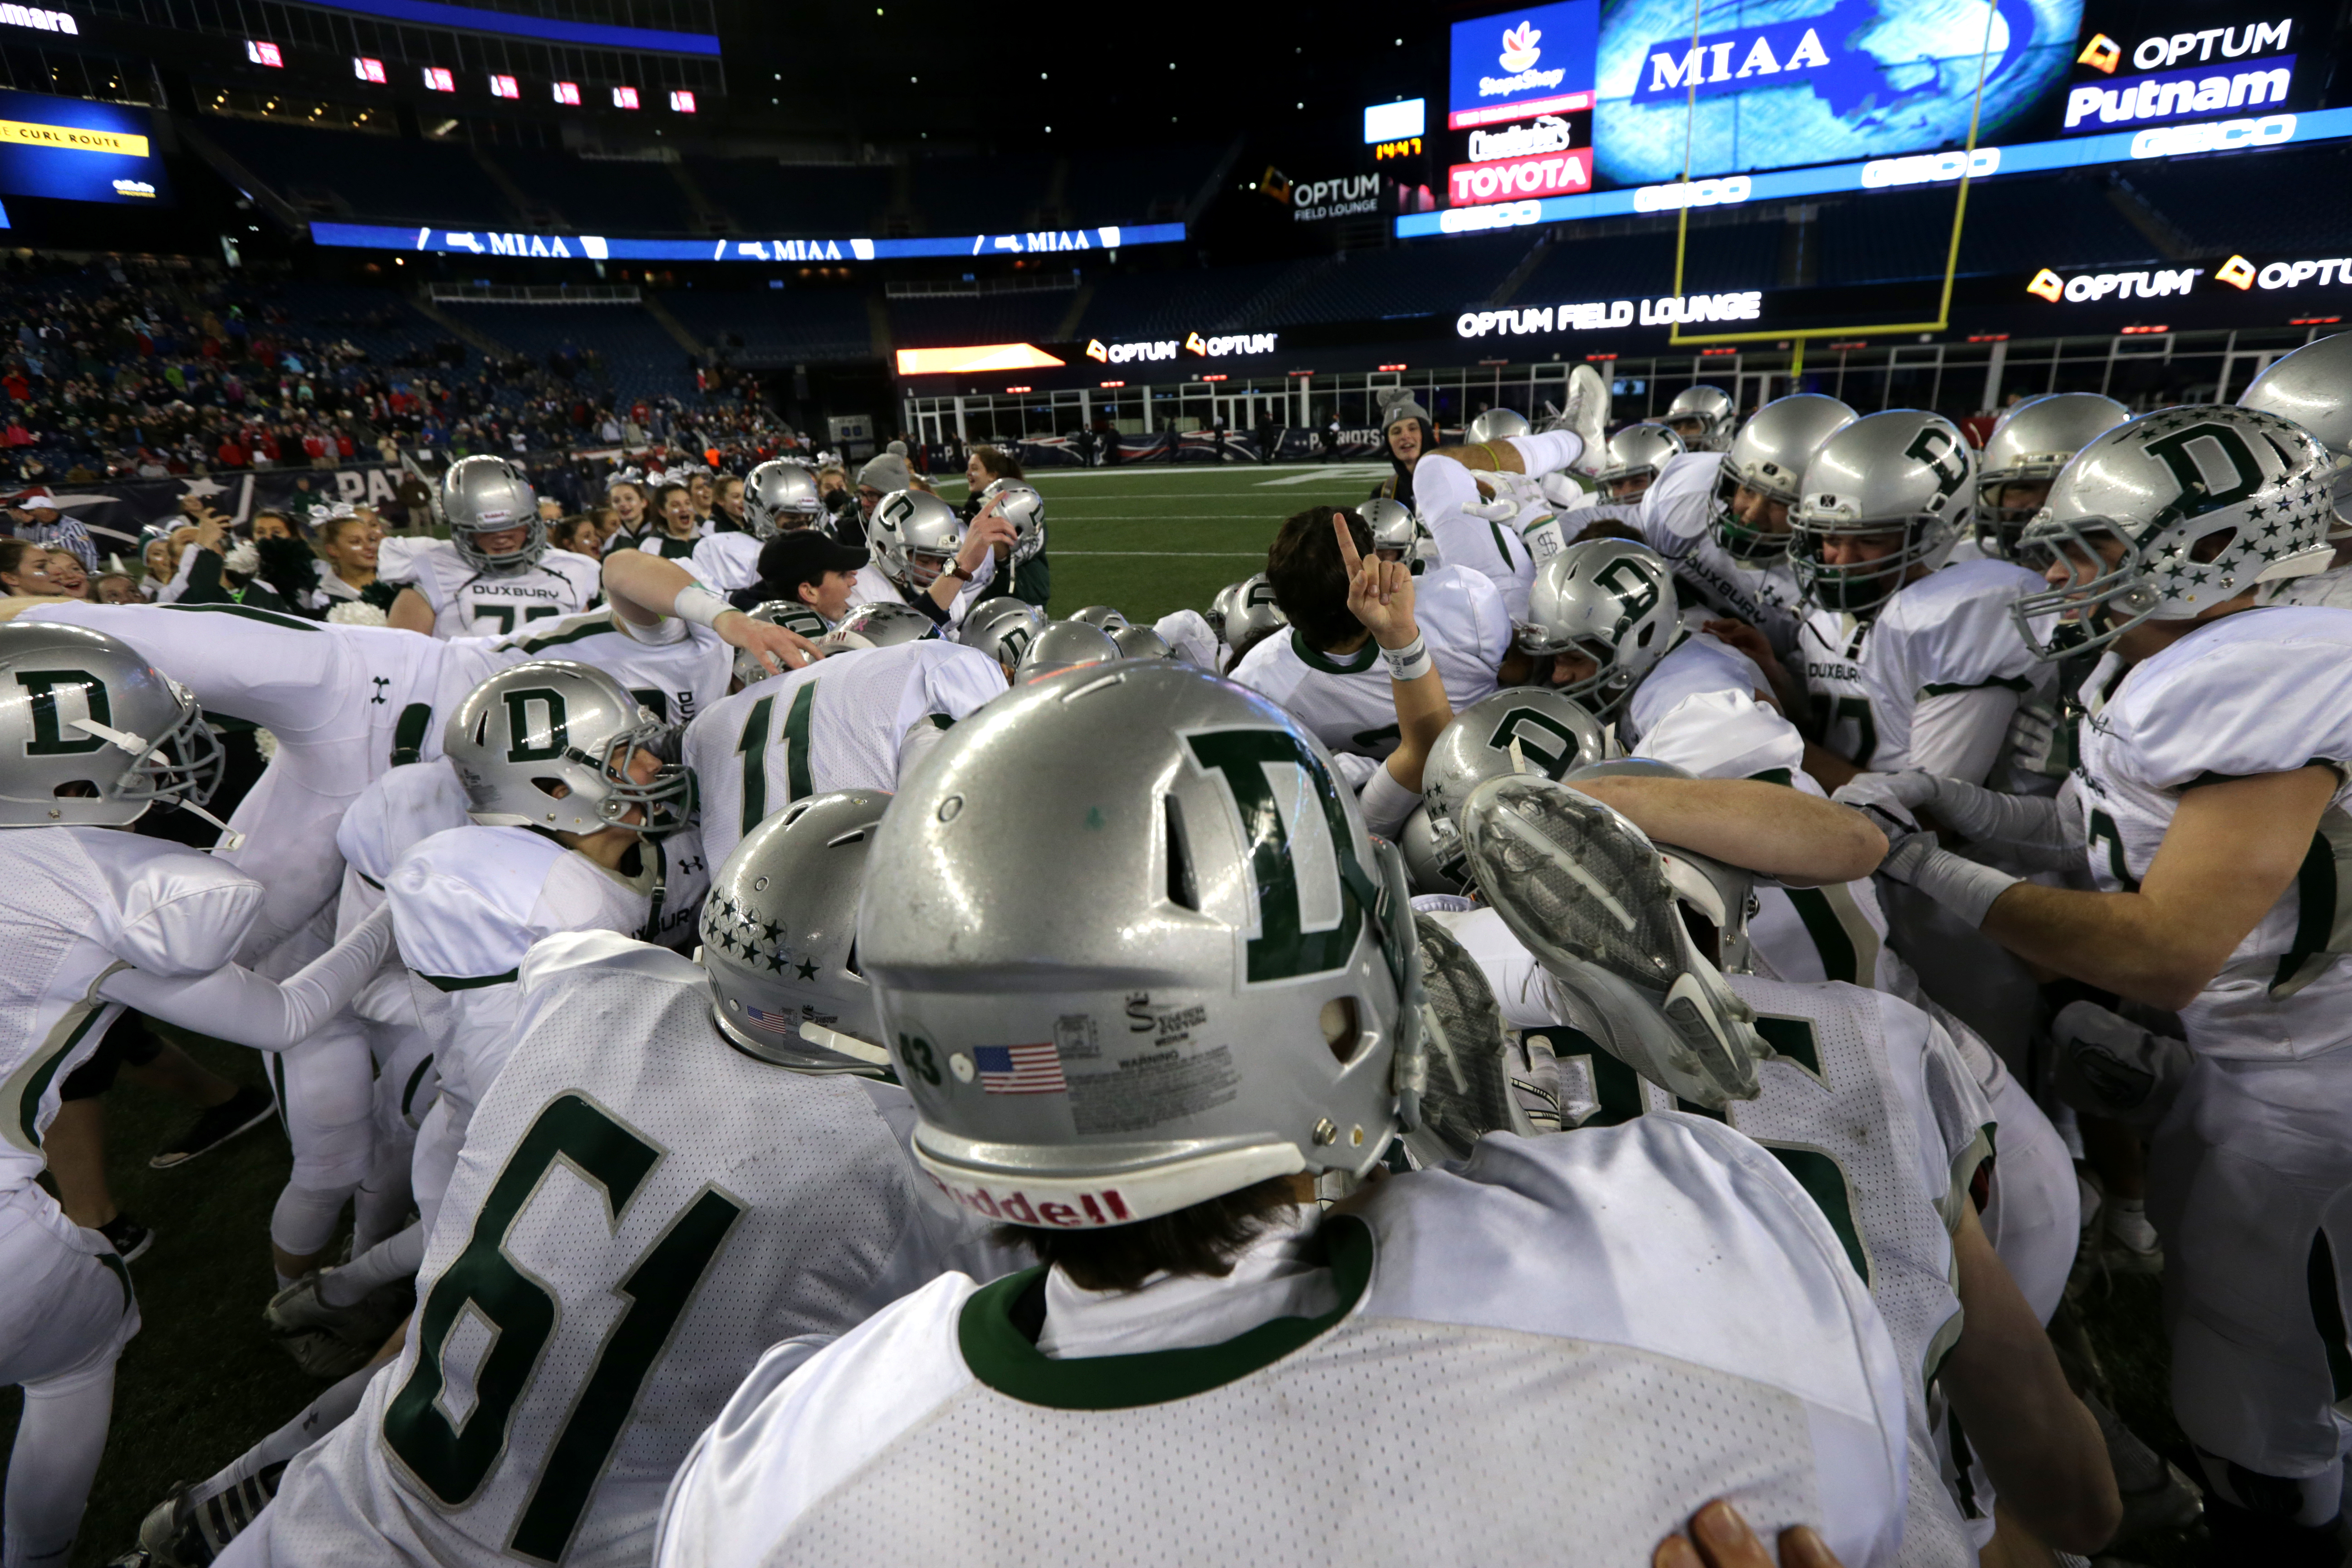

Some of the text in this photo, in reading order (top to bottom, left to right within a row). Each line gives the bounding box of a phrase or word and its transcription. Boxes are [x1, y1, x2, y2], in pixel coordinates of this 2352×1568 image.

[0, 3, 78, 35] mara
[1648, 28, 1830, 92] MIAA
[2133, 19, 2292, 70] OPTUM
[2063, 68, 2291, 128] Putnam
[20, 128, 61, 142] CURL
[69, 133, 120, 148] ROUTE
[2130, 114, 2297, 159] GEICO
[1294, 172, 1380, 207] OPTUM
[1453, 157, 1586, 199] TOYOTA
[1294, 198, 1377, 222] FIELD LOUNGE
[486, 232, 571, 259] MIAA
[772, 240, 843, 261] MIAA
[1027, 230, 1090, 253] MIAA
[2064, 269, 2195, 302] OPTUM
[1457, 291, 1761, 338] OPTUM FIELD LOUNGE
[1108, 340, 1176, 363] OPTUM
[1206, 333, 1274, 357] OPTUM
[1309, 429, 1381, 450] PRIOTS
[2140, 421, 2265, 519] D
[473, 585, 559, 599] DUXBURY
[1685, 556, 1767, 623] DUXBURY
[13, 669, 113, 758] D
[502, 687, 569, 763] D
[737, 681, 818, 839] 11
[1487, 706, 1581, 779] D
[1176, 726, 1366, 990] D
[382, 1089, 752, 1568] 61
